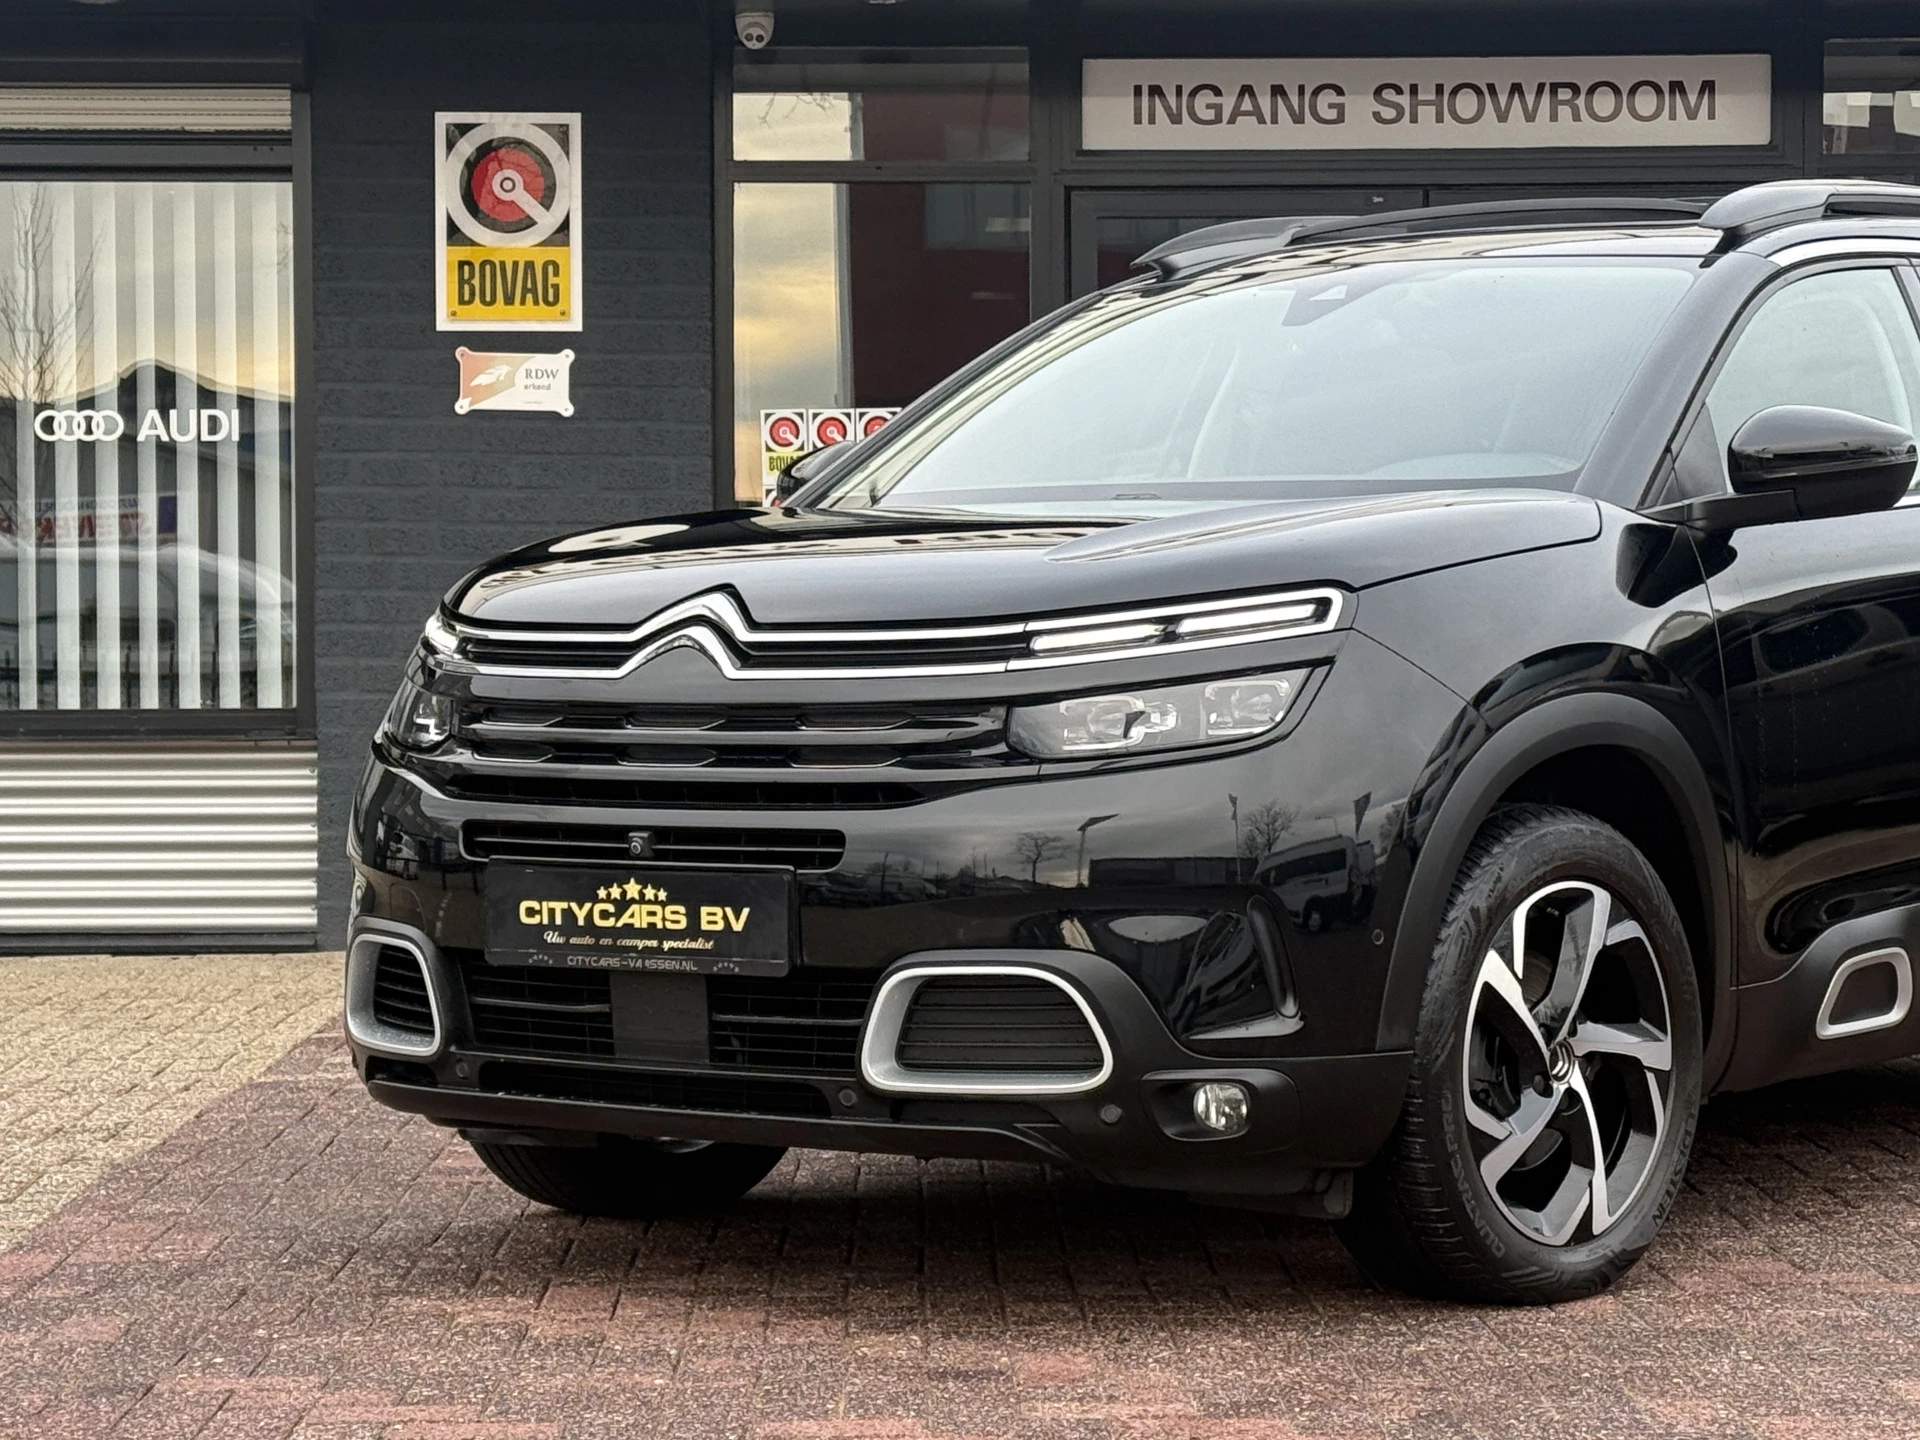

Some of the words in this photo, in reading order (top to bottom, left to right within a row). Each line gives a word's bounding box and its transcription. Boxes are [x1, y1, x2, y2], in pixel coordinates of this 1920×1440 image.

[1133, 83, 1345, 126] INGANG
[1372, 79, 1716, 125] SHOWROOM
[457, 259, 560, 307] BOVAG
[525, 368, 560, 380] RDW
[136, 408, 240, 442] AUDI
[768, 455, 794, 471] BOV
[519, 900, 688, 930] CITYCARS
[700, 906, 750, 932] BV
[543, 930, 566, 945] Uw
[569, 935, 595, 945] auto
[599, 937, 613, 946] en
[617, 938, 659, 950] camper
[660, 938, 714, 951] specialist
